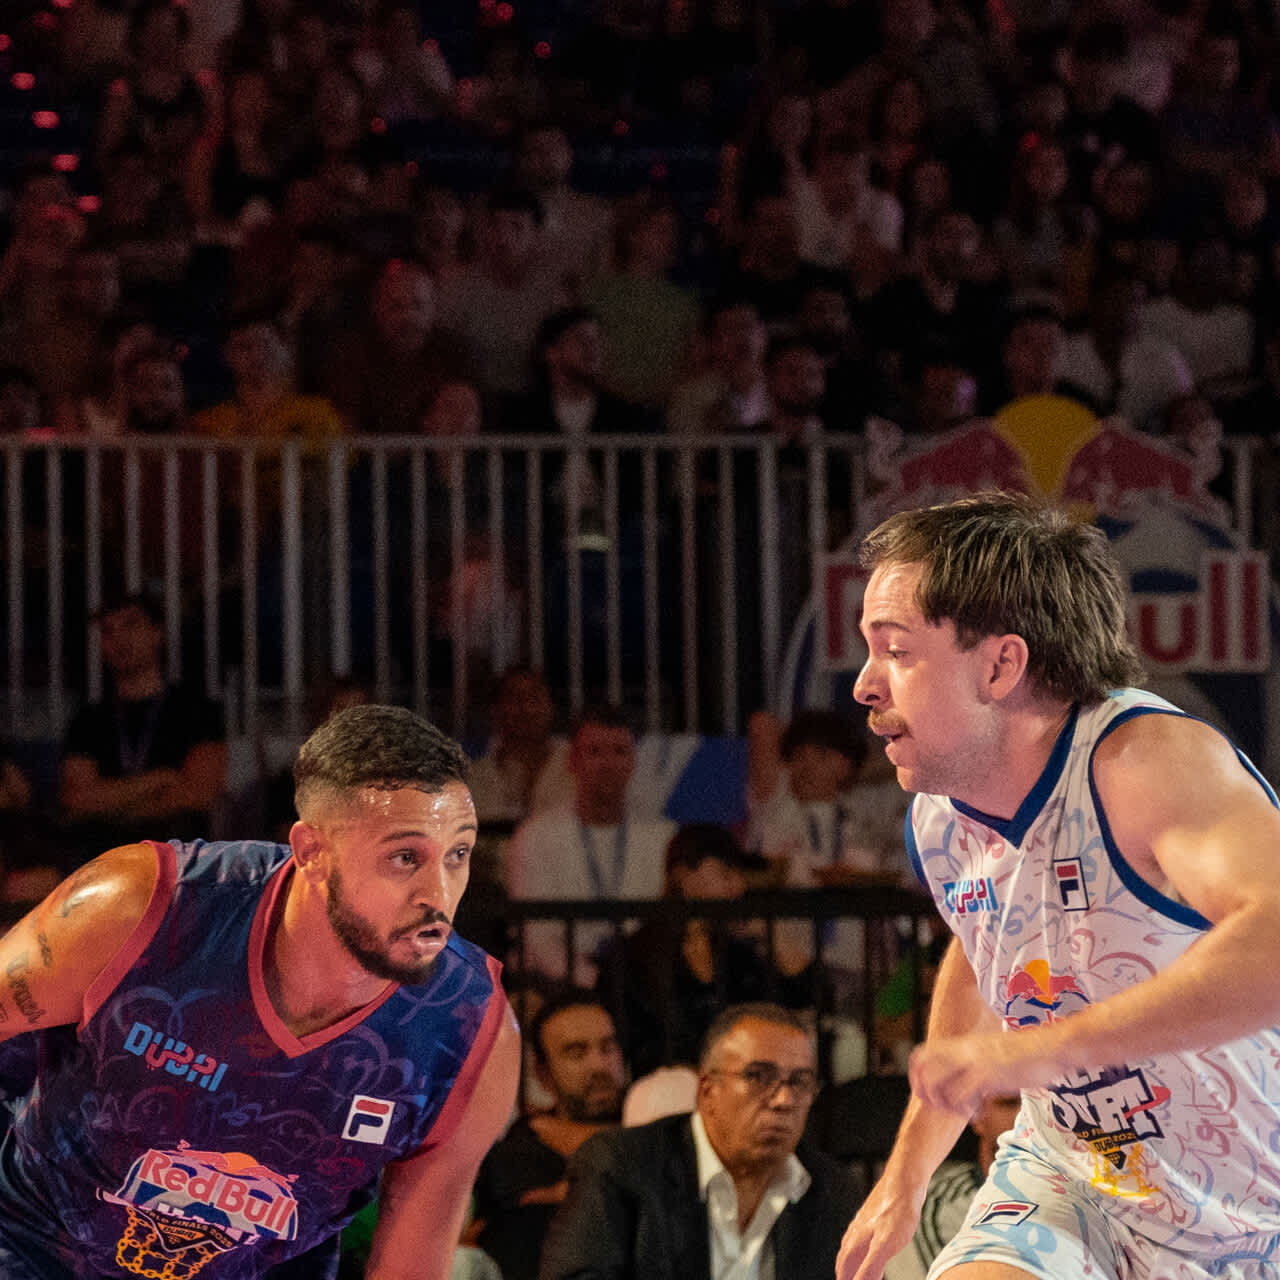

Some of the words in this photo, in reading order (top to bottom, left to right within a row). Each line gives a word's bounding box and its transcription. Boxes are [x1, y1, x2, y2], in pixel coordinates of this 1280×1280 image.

[1124, 560, 1262, 663] ull
[123, 1022, 229, 1092] DUBAI
[138, 1150, 221, 1205] Red
[215, 1178, 298, 1232] Bull
